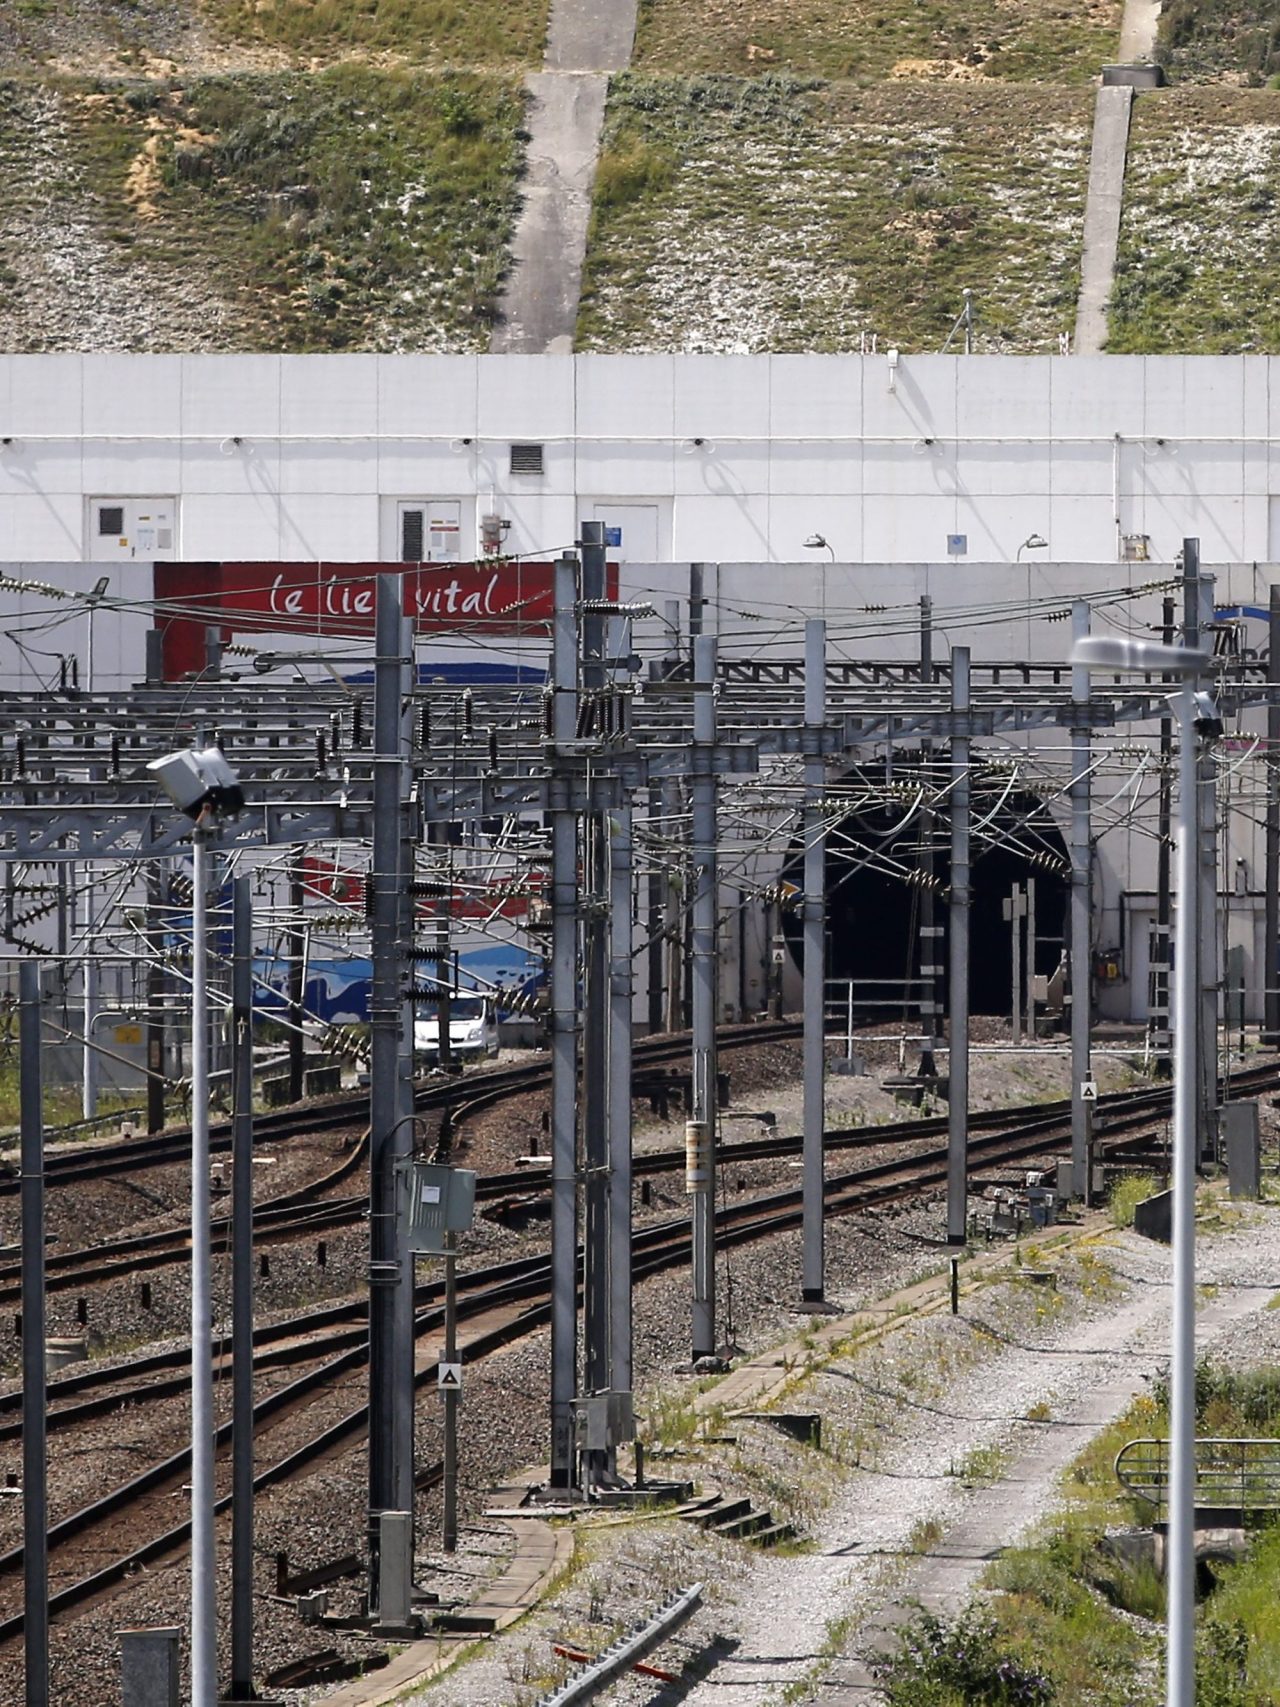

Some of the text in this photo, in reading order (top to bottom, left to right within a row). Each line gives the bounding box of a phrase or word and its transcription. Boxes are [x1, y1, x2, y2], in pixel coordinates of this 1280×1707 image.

[270, 573, 498, 615] le lie vital
